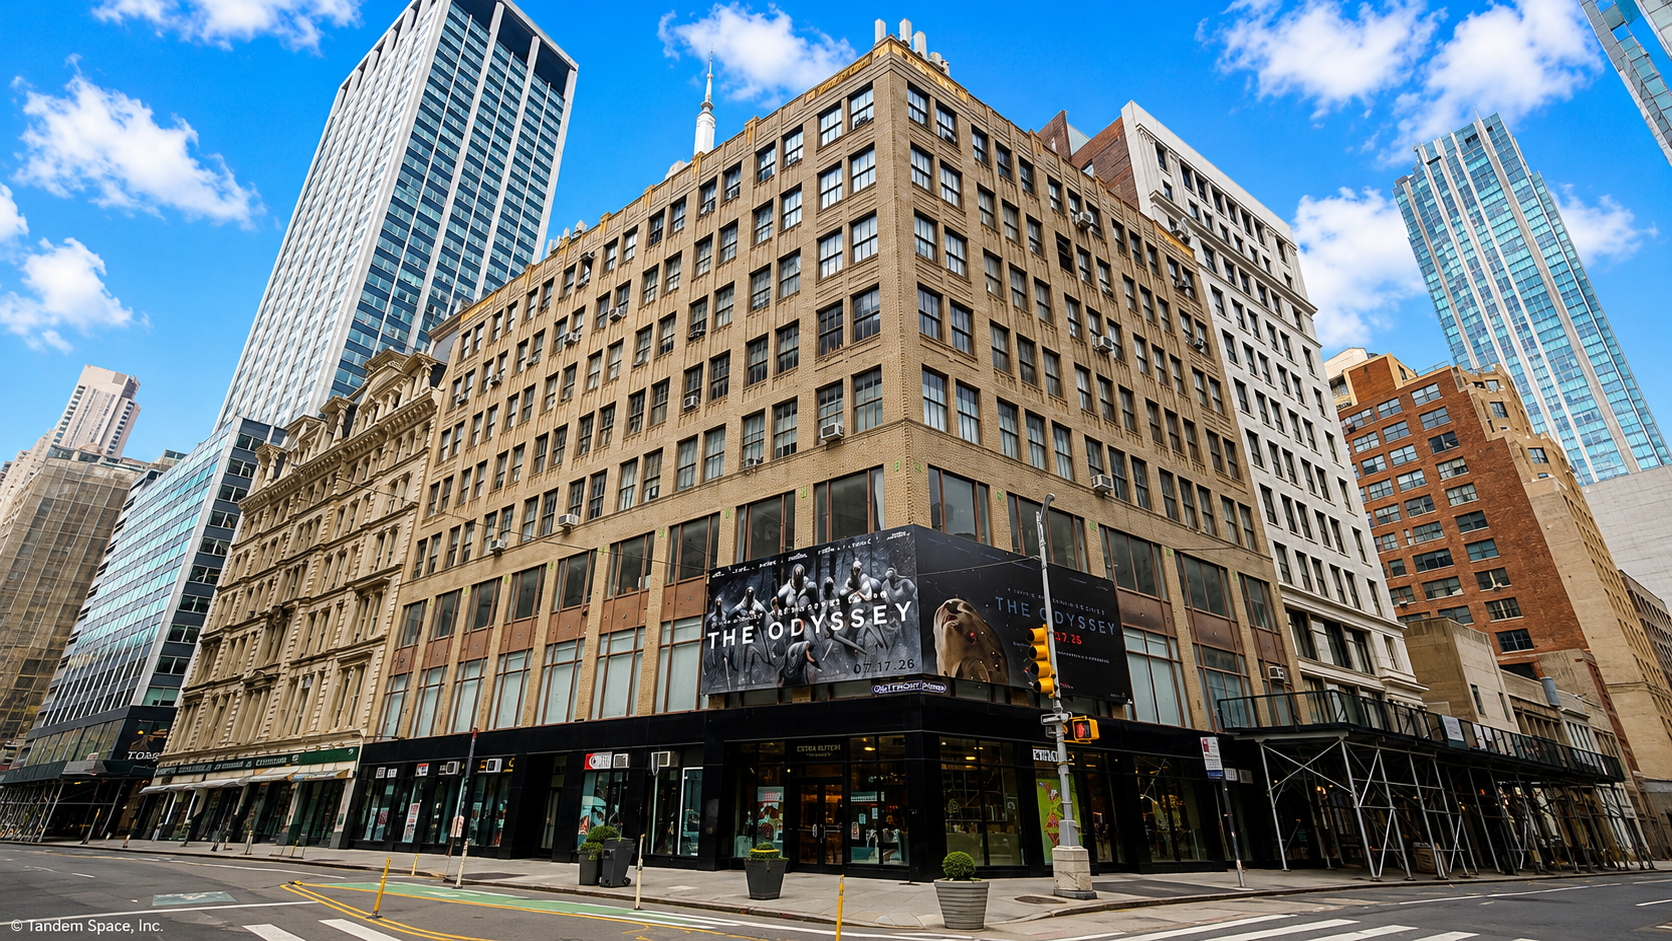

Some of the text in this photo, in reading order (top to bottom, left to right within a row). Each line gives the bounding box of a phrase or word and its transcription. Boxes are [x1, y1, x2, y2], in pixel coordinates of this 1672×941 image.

[708, 625, 755, 650] THE
[768, 600, 912, 641] ODYSSEY
[995, 595, 1031, 618] THE
[1039, 607, 1115, 636] ODYSSEY
[853, 658, 916, 675] 07.17.26
